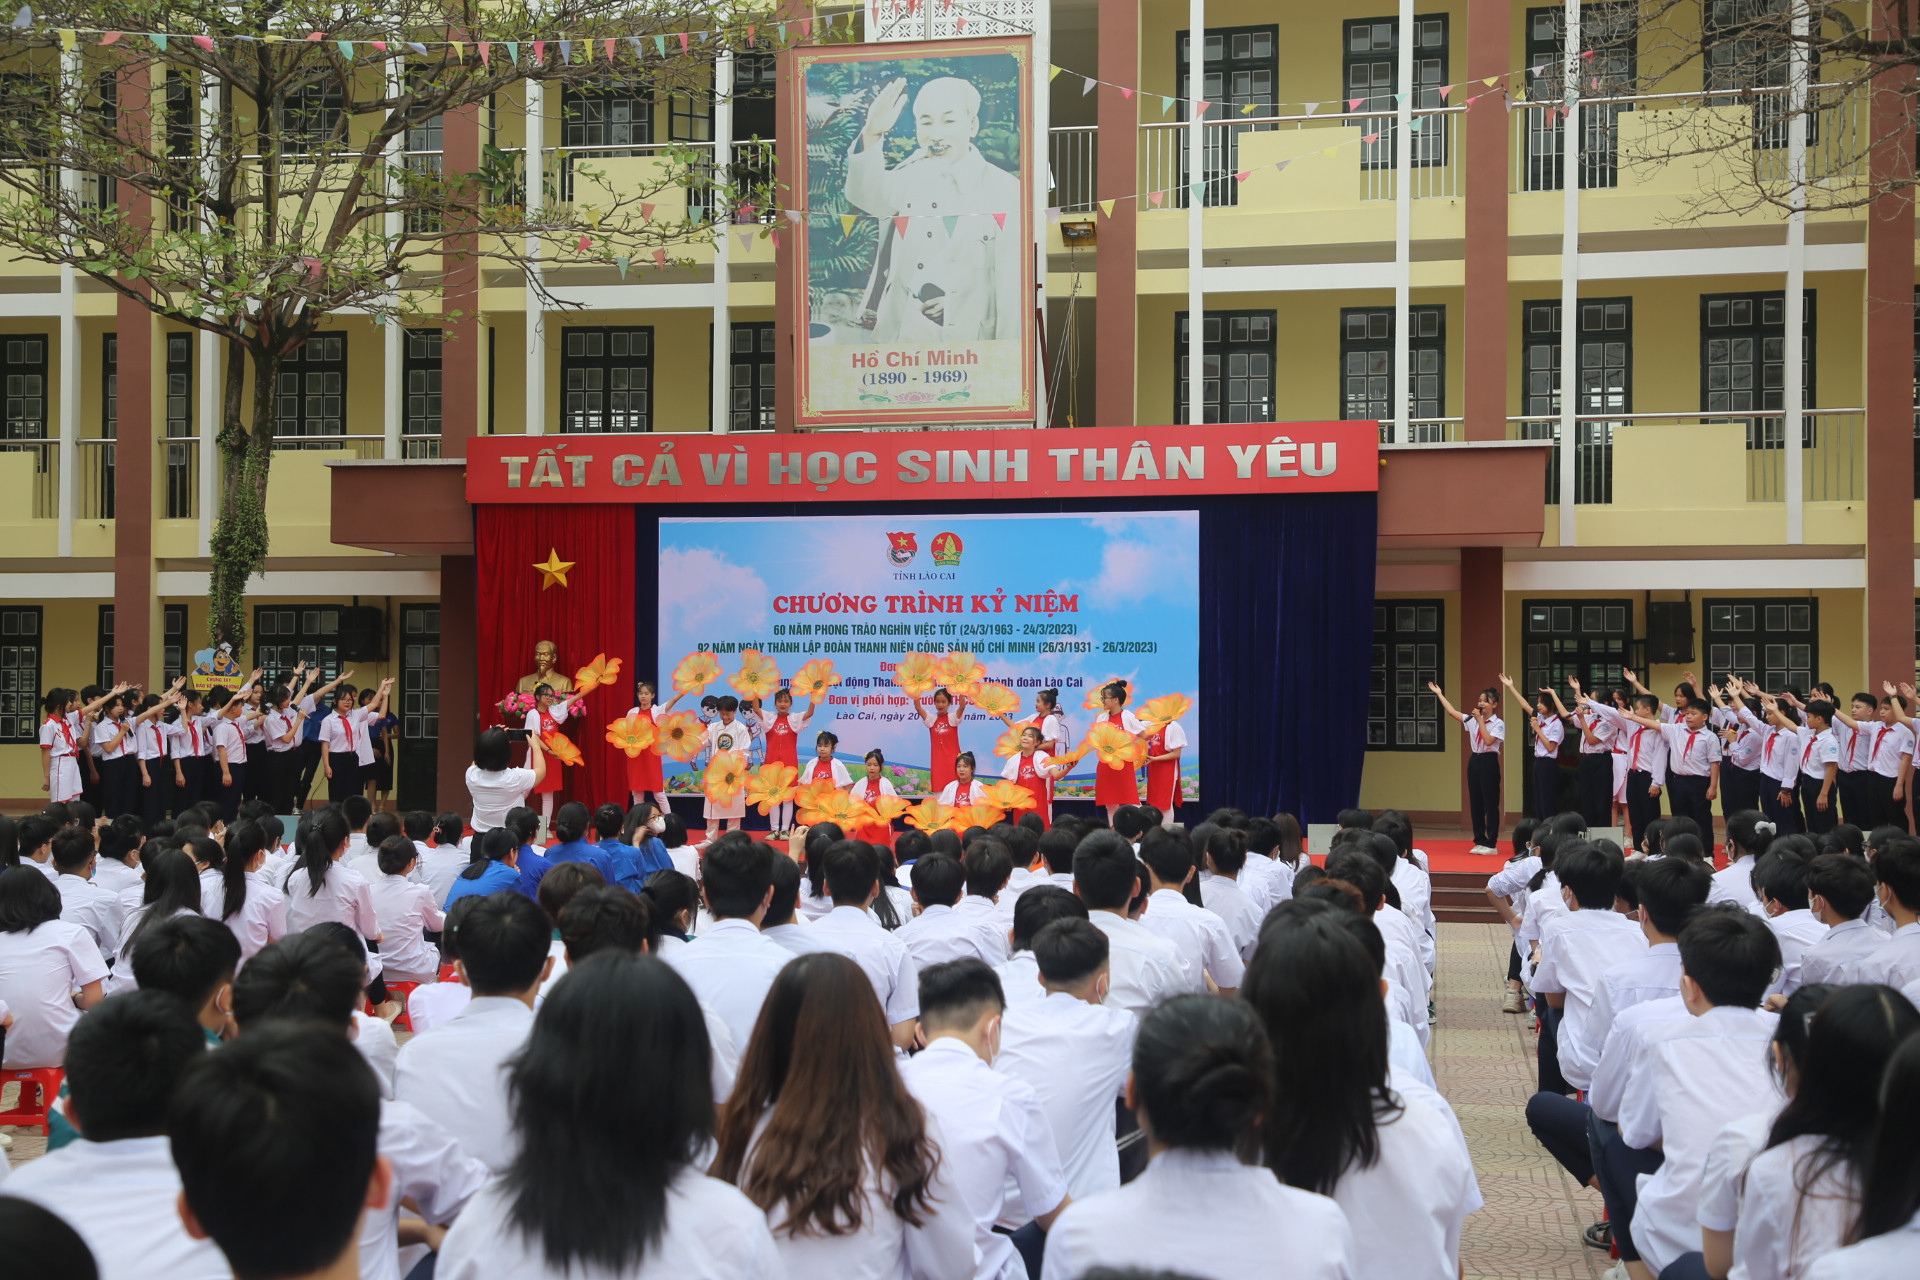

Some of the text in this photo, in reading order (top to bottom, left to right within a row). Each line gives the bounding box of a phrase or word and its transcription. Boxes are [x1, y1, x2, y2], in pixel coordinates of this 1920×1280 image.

[852, 349, 978, 368] Hồ Chí Minh
[862, 371, 907, 387] (1890
[923, 370, 968, 383] 1969)
[500, 436, 1337, 492] TẤT CẢ VÌ HỌC SINH THÂN YÊU
[893, 571, 916, 580] TỈNH
[919, 571, 937, 580] LÀO
[773, 588, 1079, 617] CHƯƠNG TRÌNH KỶ NIỆM
[773, 625, 786, 636] 60
[789, 622, 812, 636] NĂM
[815, 624, 849, 635] PHONG
[851, 622, 877, 635] TRÀO
[880, 623, 911, 636] NGHÌN
[914, 623, 936, 637] VIỆC
[939, 621, 957, 635] TỐT
[960, 624, 1013, 636] (24/3/1963
[1023, 623, 1077, 636] 24/3/2023)
[697, 642, 710, 652] 92
[712, 640, 736, 653] NĂM
[738, 640, 764, 653] NGÀY
[768, 640, 800, 653] THÀNH
[802, 641, 821, 655] LẬP
[824, 640, 851, 653] ĐOÀN
[854, 642, 888, 653] THANH
[895, 640, 914, 653] NIÊN
[917, 640, 944, 653] CÔNG
[948, 639, 968, 652] SẢN
[971, 639, 985, 652] HỒ
[988, 640, 1005, 653] CHÍ
[1008, 642, 1035, 653] MINH
[1038, 642, 1091, 654] (26/3/1931
[1102, 641, 1157, 654] 26/3/2023)
[845, 677, 870, 689] động
[873, 677, 902, 687] Than
[1016, 677, 1042, 688] đoàn
[1045, 677, 1063, 687] Lào
[1066, 677, 1083, 687] Cai
[828, 695, 847, 704] Đơn
[851, 695, 860, 707] vị
[863, 693, 884, 706] phối
[888, 695, 909, 707] hợp:
[836, 711, 855, 720] Lào
[858, 711, 877, 721] Cai,
[880, 712, 905, 722] ngày
[908, 712, 920, 720] 20
[964, 712, 986, 720] năm
